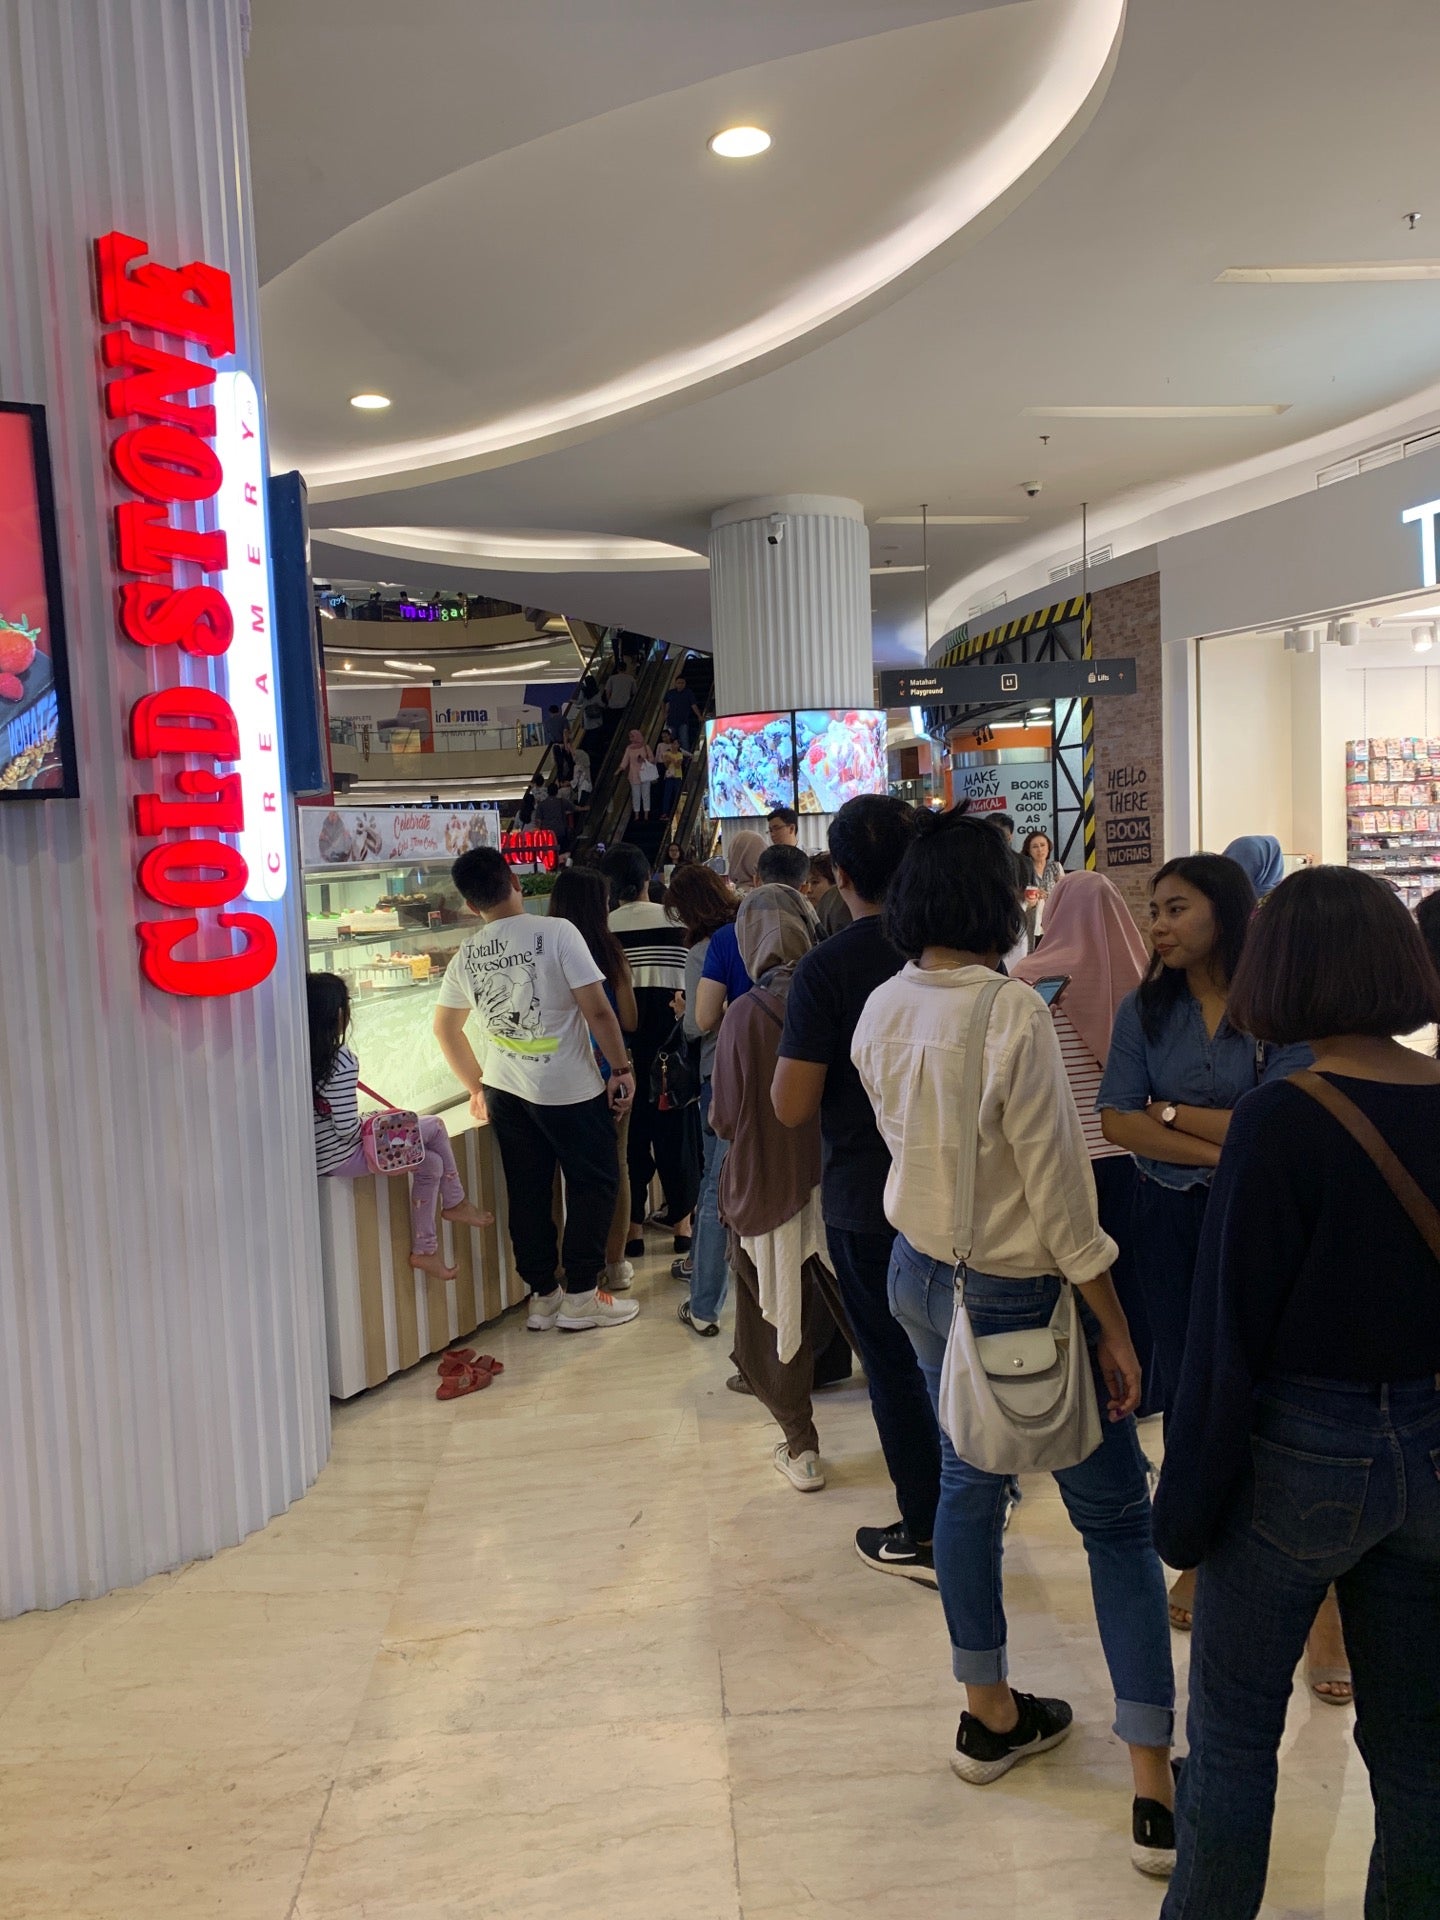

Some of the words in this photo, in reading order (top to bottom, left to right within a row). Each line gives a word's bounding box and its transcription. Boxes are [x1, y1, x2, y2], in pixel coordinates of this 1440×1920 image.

[95, 231, 235, 657] STONE
[241, 419, 281, 874] CREAMERY
[1097, 674, 1109, 682] Lifts
[910, 687, 943, 696] Playground
[435, 708, 488, 723] informa
[963, 769, 998, 787] MAKE
[1011, 780, 1049, 790] BOOKS
[1108, 766, 1147, 788] HELLO
[963, 782, 1000, 799] TODAY
[1021, 792, 1043, 800] ARE
[390, 803, 498, 812] TAHARI
[1015, 803, 1047, 812] GOOD
[1107, 791, 1148, 813] THERE
[394, 812, 430, 840] Celebrate
[1025, 814, 1040, 823] AS
[1017, 825, 1047, 835] GOLD
[1108, 821, 1149, 839] BOOK
[130, 686, 278, 996] COLD
[1108, 847, 1150, 862] WORMS
[465, 938, 508, 959] Totally
[464, 950, 533, 974] Awesome
